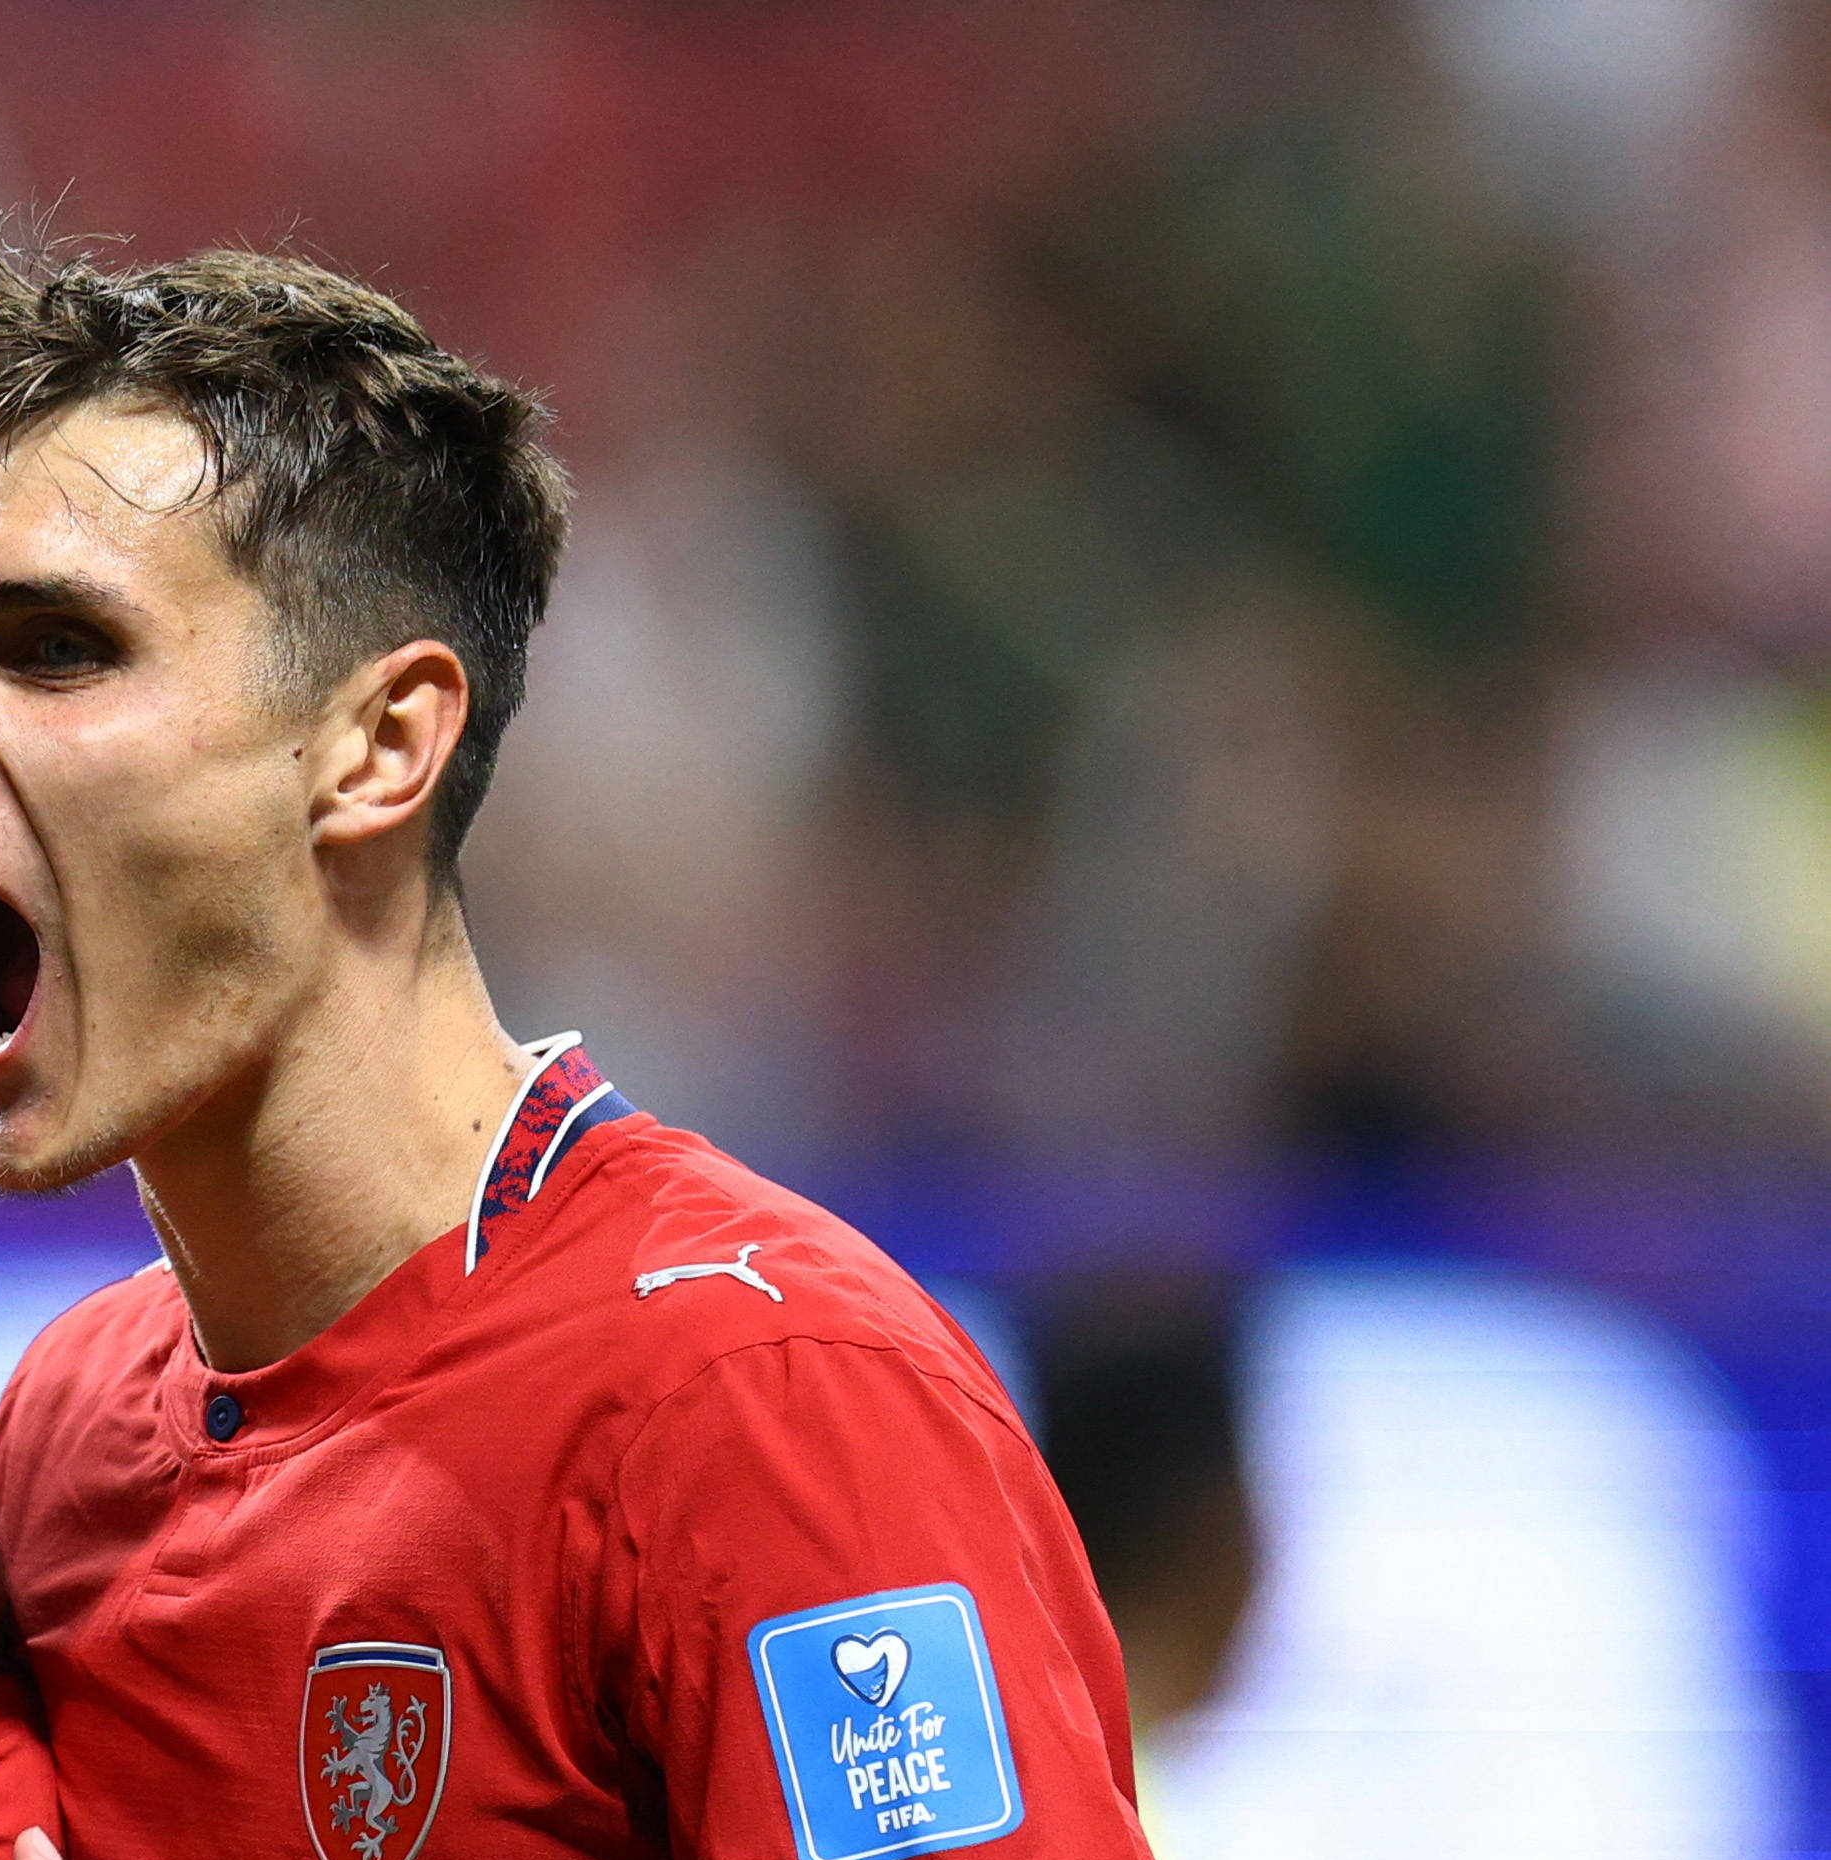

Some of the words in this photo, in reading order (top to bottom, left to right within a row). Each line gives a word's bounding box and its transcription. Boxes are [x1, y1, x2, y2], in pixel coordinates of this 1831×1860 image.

[831, 1715, 902, 1767] Unite
[899, 1701, 946, 1749] For
[846, 1748, 951, 1810] PEACE
[876, 1802, 936, 1834] FIFA
